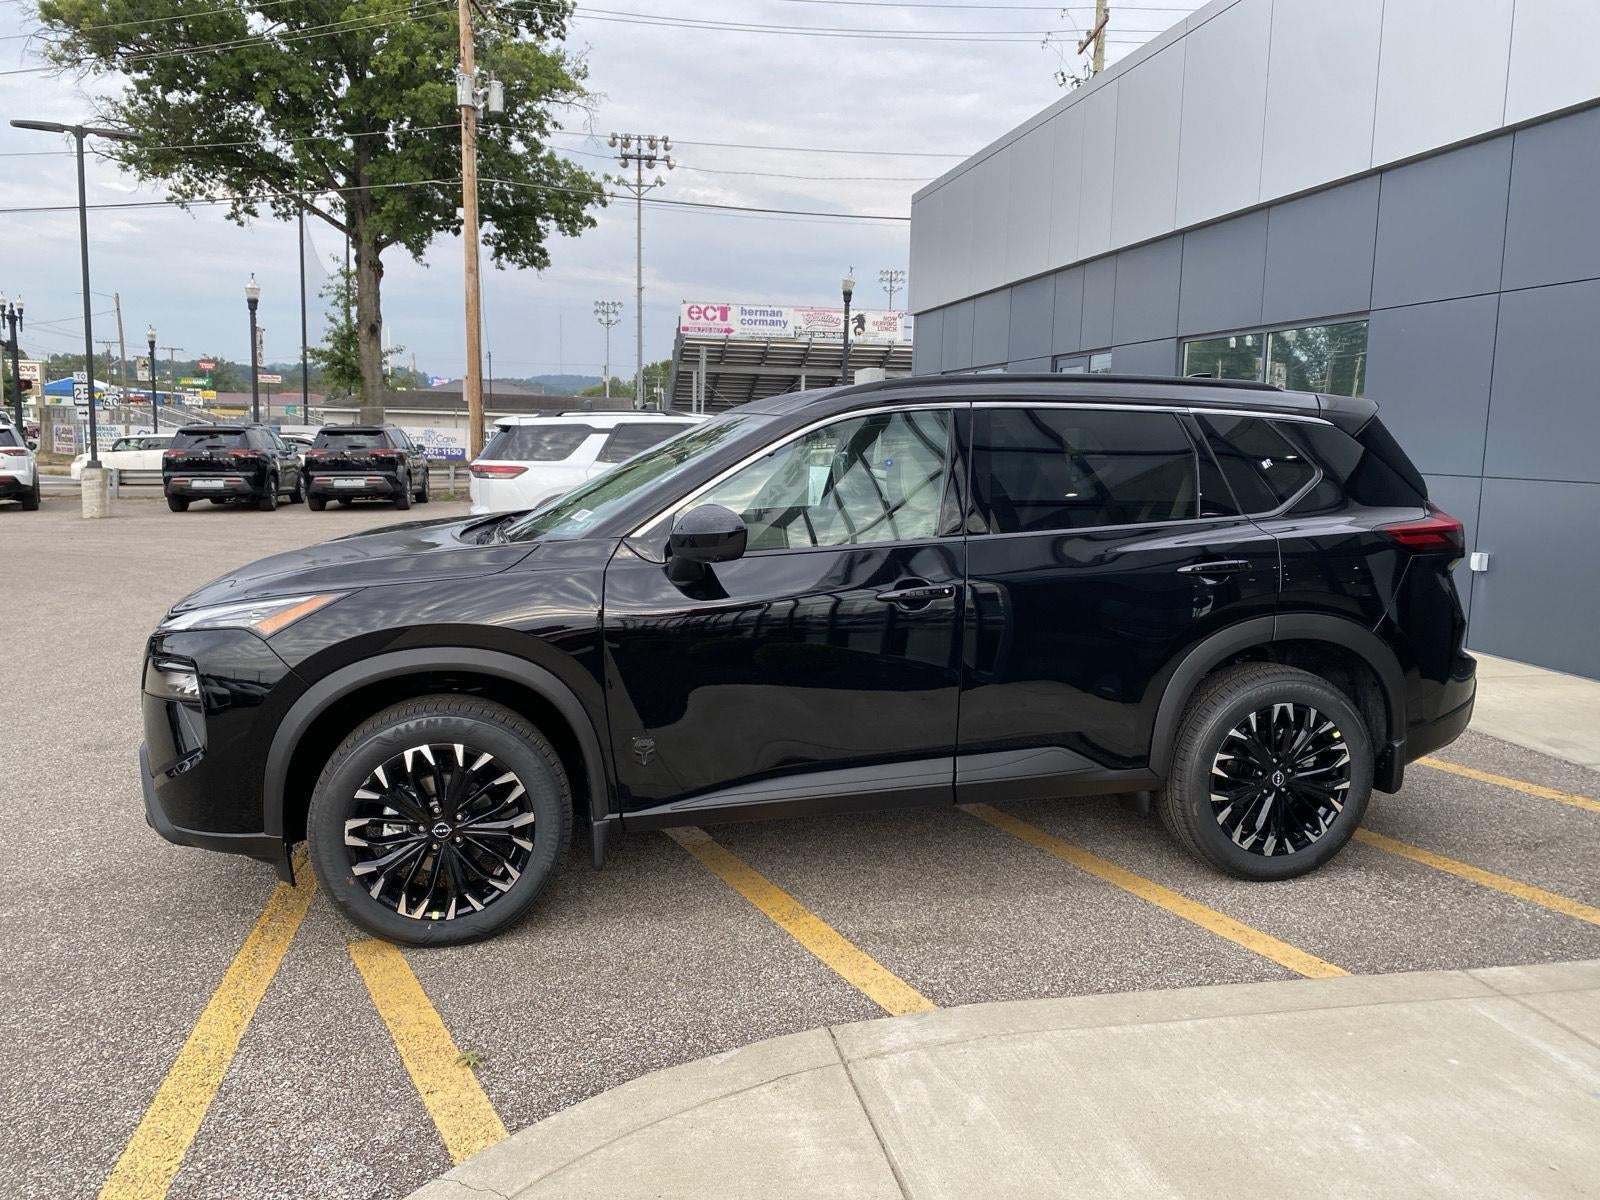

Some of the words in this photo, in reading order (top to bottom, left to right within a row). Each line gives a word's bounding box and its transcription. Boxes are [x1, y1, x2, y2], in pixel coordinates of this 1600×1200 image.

[740, 306, 783, 318] herman
[740, 317, 789, 329] cormany
[75, 387, 89, 400] 25
[104, 397, 119, 407] 60
[423, 447, 462, 455] 201-1130
